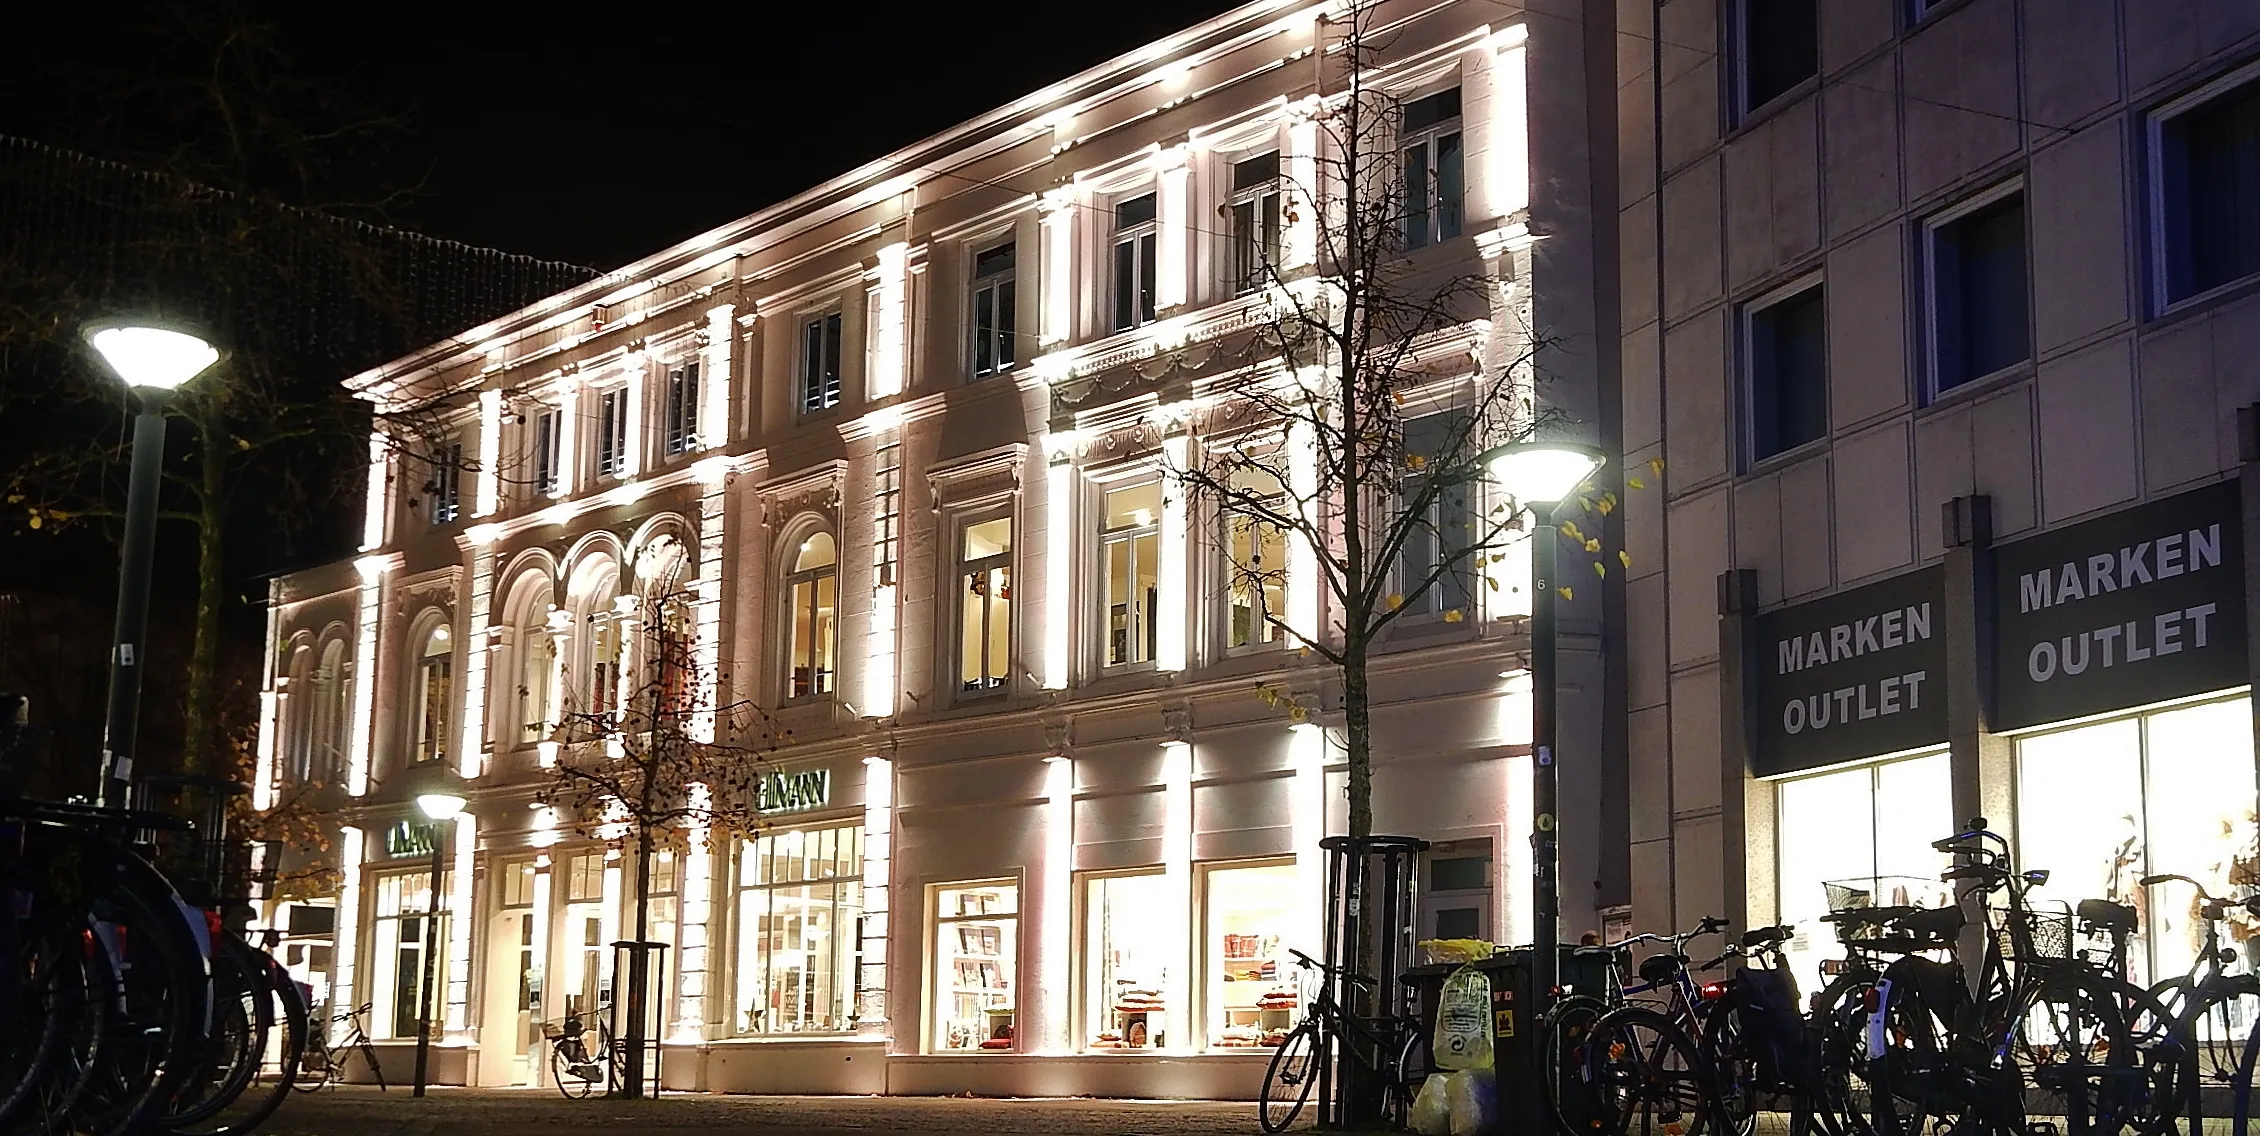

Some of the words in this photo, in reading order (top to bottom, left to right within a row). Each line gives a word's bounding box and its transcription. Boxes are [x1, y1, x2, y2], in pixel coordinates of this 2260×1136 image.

[1537, 579, 1546, 590] 6
[2019, 523, 2221, 614] MARKEN
[1778, 602, 1931, 675] MARKEN
[2028, 602, 2216, 682] OUTLET
[1783, 670, 1926, 734] OUTLET
